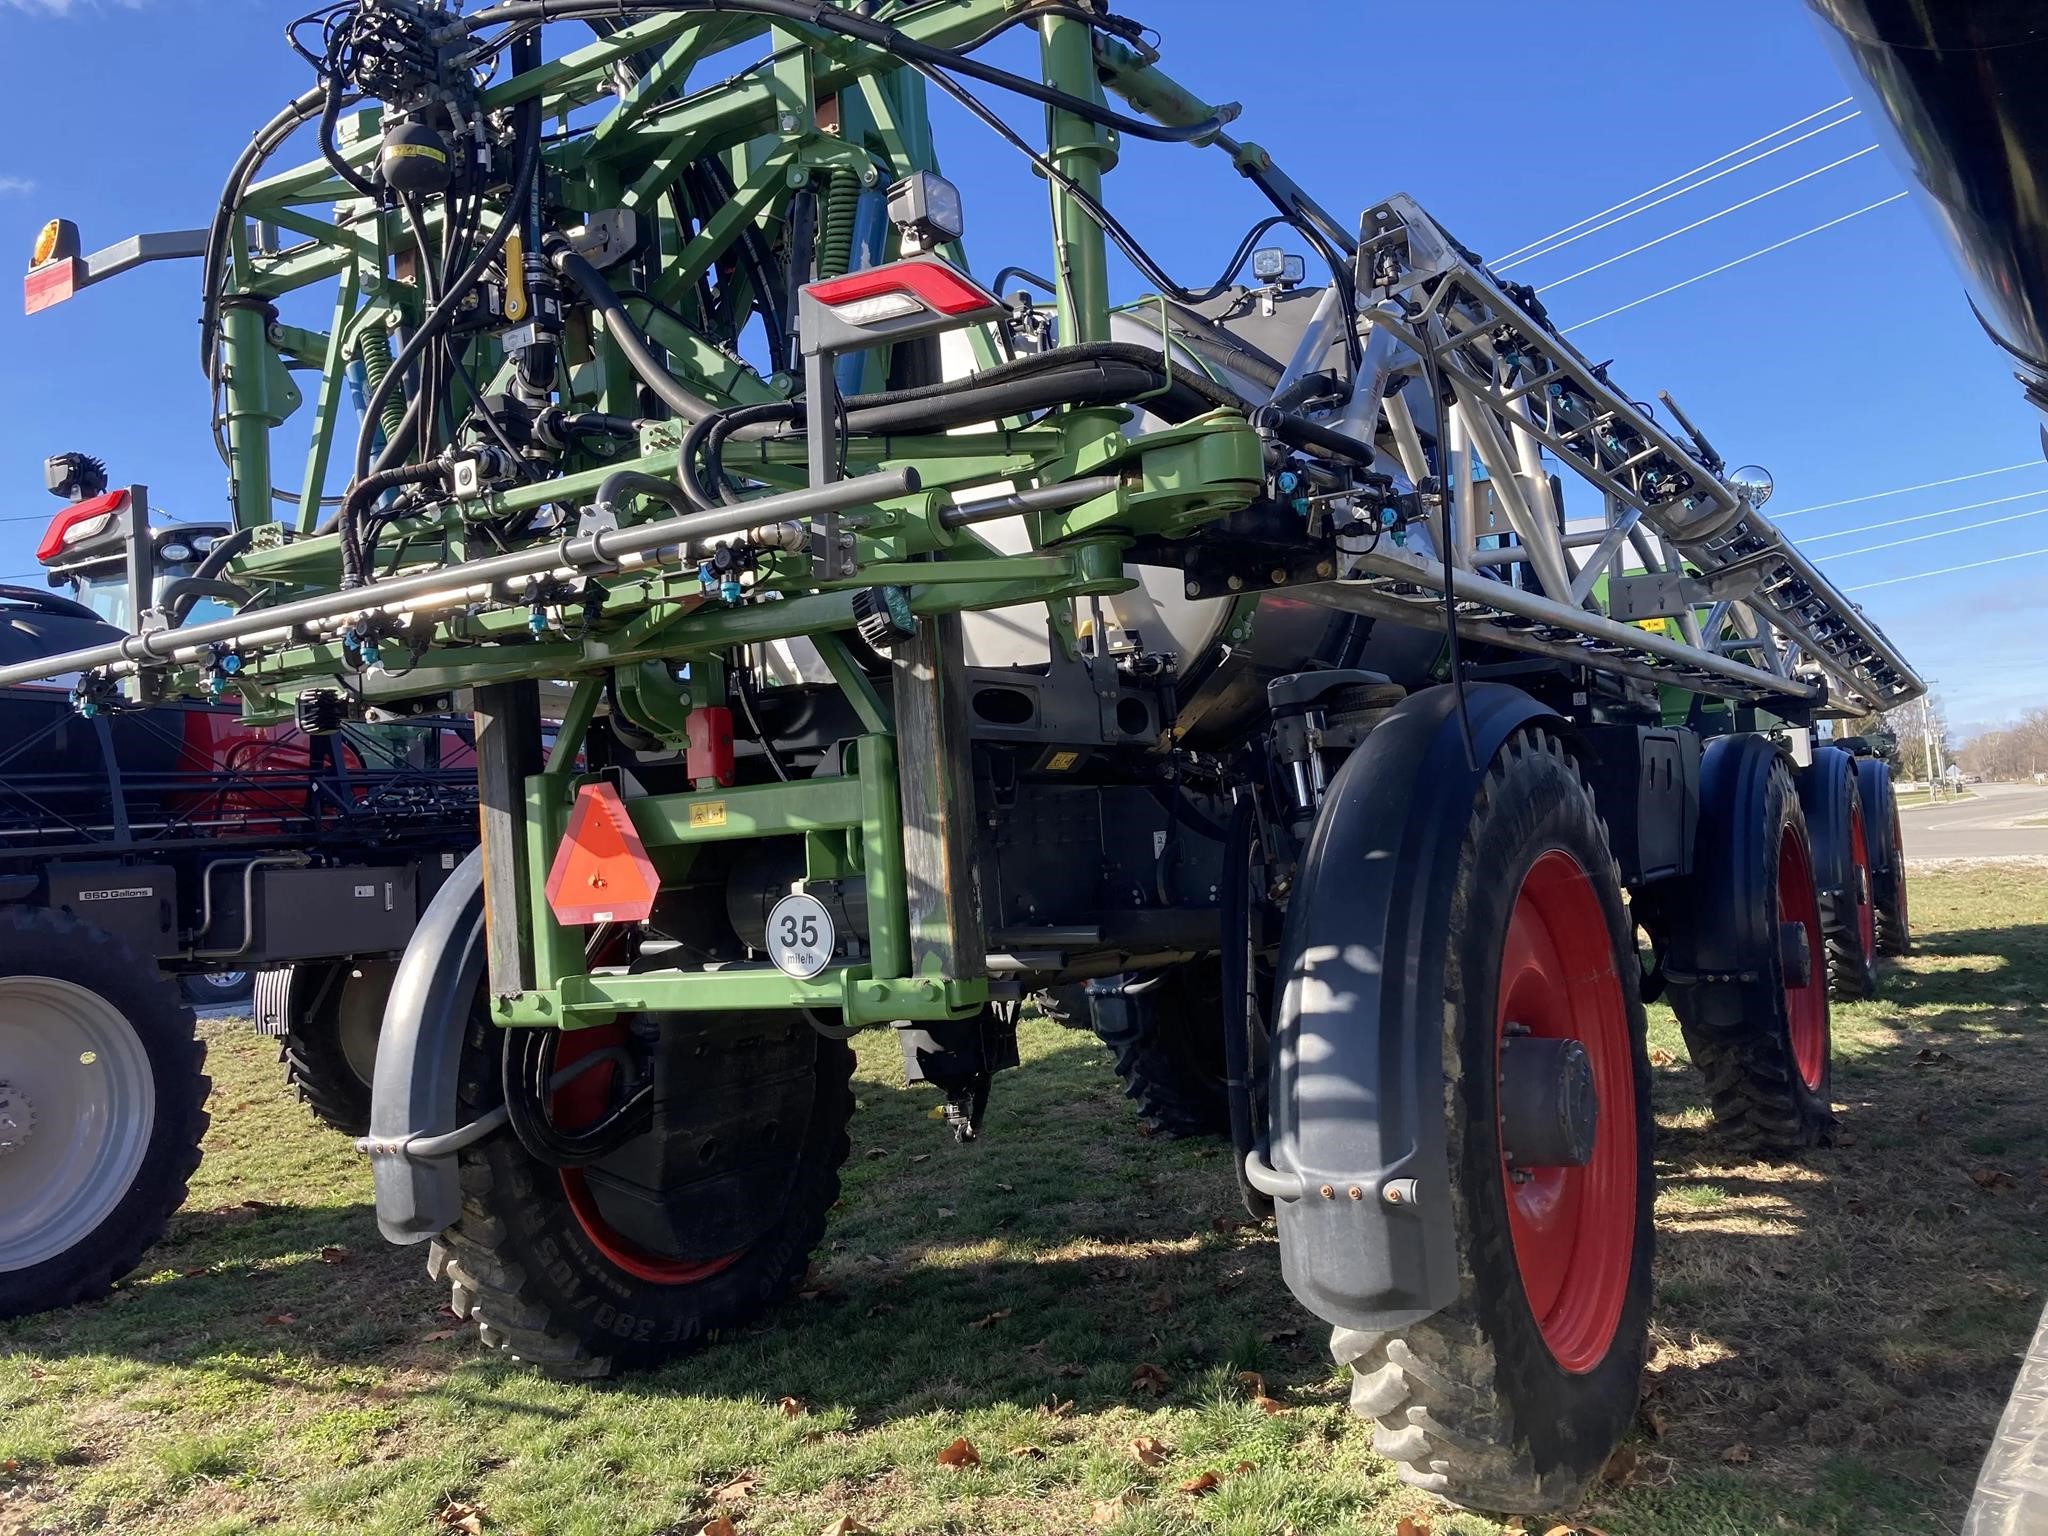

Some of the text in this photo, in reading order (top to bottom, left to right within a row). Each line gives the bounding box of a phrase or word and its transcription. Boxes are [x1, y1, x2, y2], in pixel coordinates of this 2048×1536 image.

[111, 889, 148, 898] Gallons
[780, 915, 818, 948] 35
[787, 953, 814, 965] mile/h
